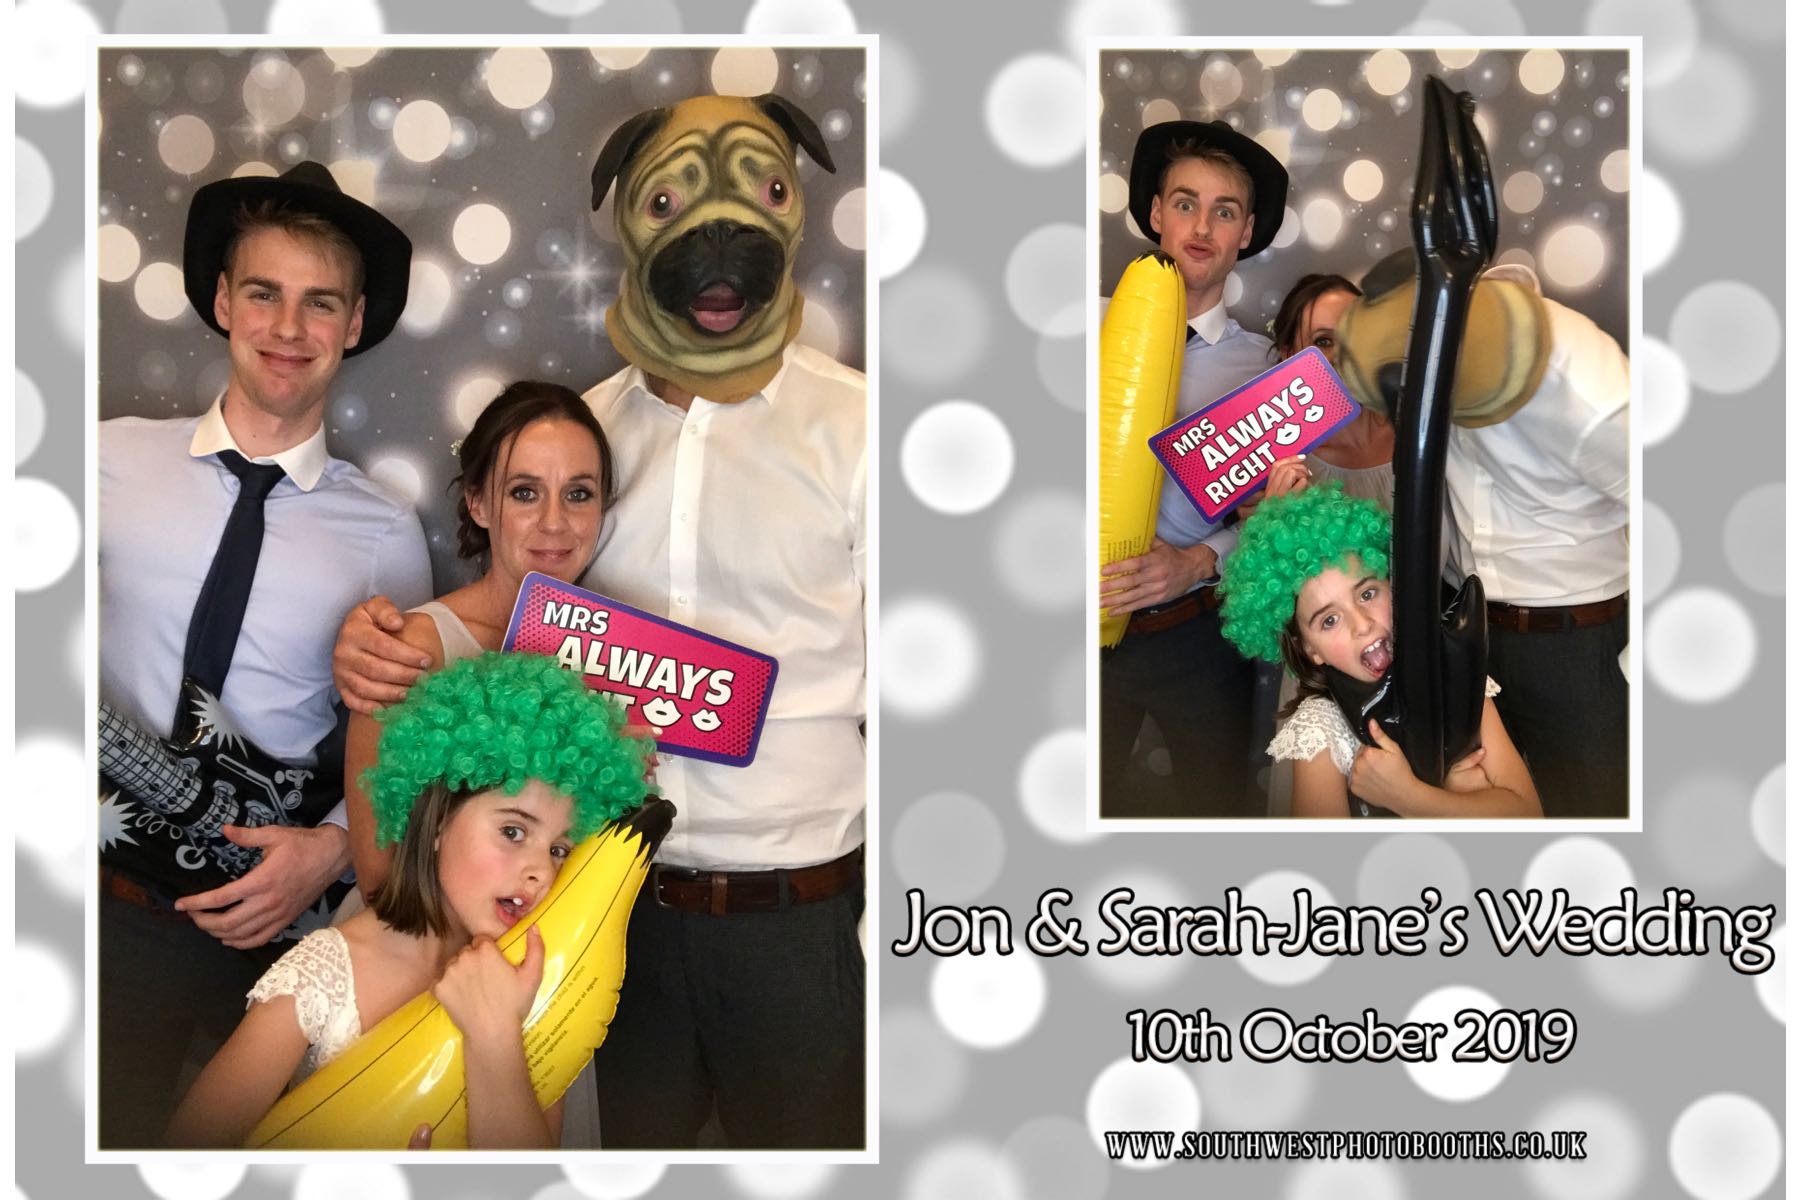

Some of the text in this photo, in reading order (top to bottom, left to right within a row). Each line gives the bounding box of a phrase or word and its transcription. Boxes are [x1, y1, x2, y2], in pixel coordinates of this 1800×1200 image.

[1172, 417, 1217, 457] MRS
[1200, 376, 1314, 472] ALWAYS
[1204, 441, 1276, 505] RIGHT
[542, 600, 610, 635] MRS
[556, 635, 735, 706] ALWAYS
